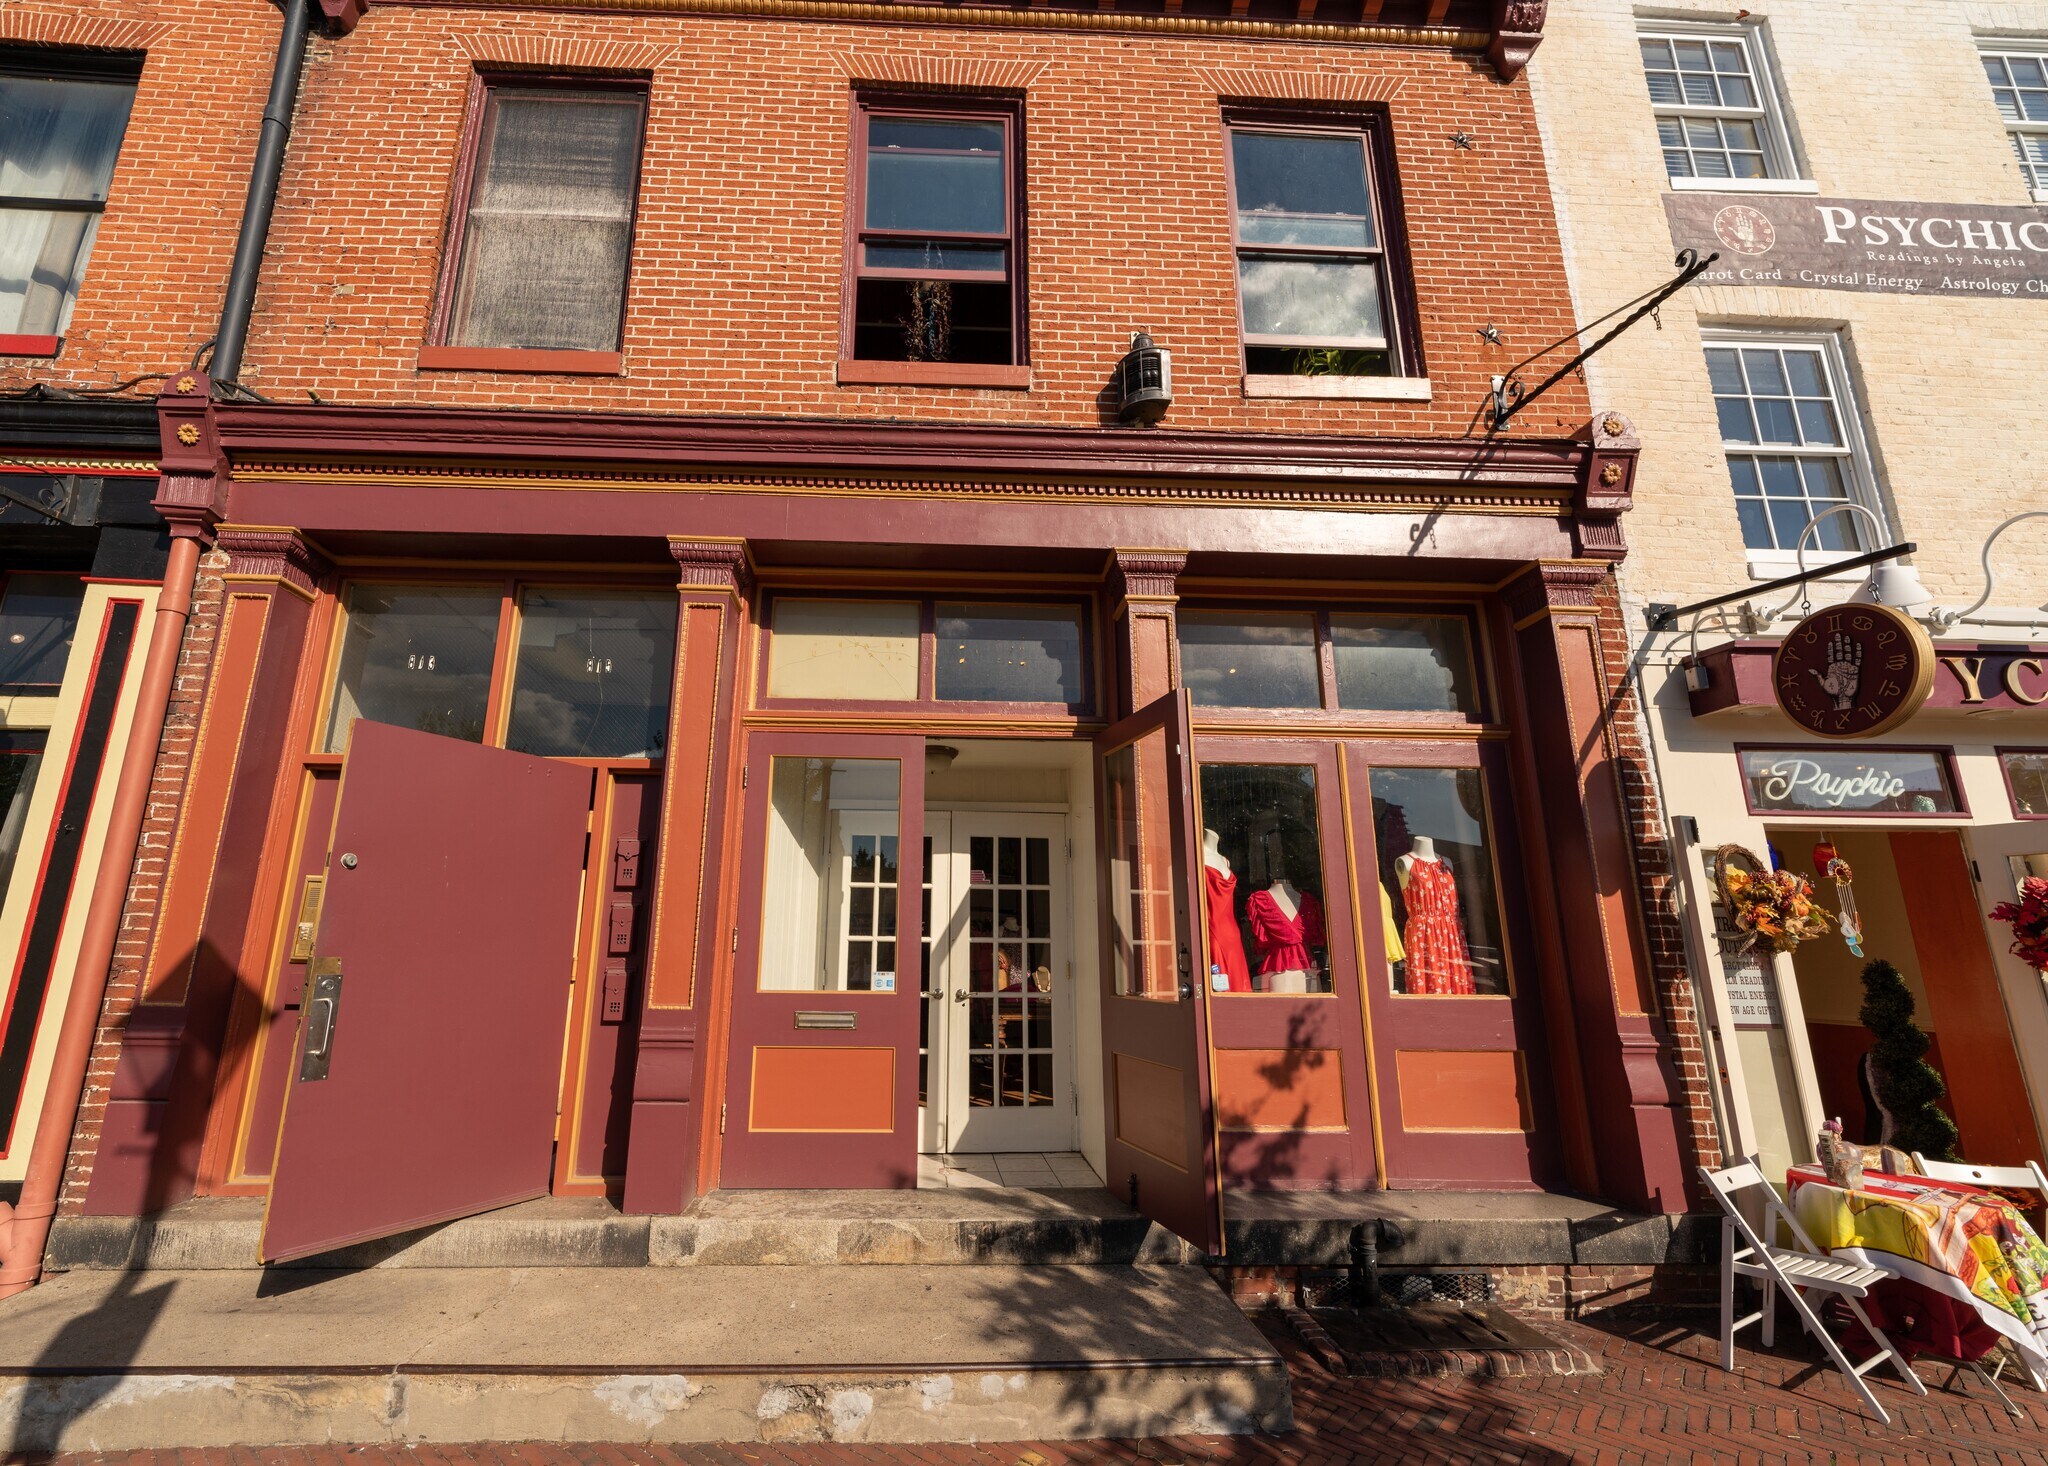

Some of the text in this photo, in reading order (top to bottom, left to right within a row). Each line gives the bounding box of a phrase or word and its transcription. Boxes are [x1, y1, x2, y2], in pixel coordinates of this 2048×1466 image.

[1866, 251, 2025, 268] Readings by Angela
[1696, 268, 2048, 295] arot Card Crystal Energy Astrology Ch
[1940, 657, 2048, 706] YC
[1765, 759, 1906, 806] Psychic
[1740, 976, 1769, 986] READING
[1728, 991, 1747, 1000] YSTAL
[1730, 1005, 1776, 1016] EW AGE GIFTS
